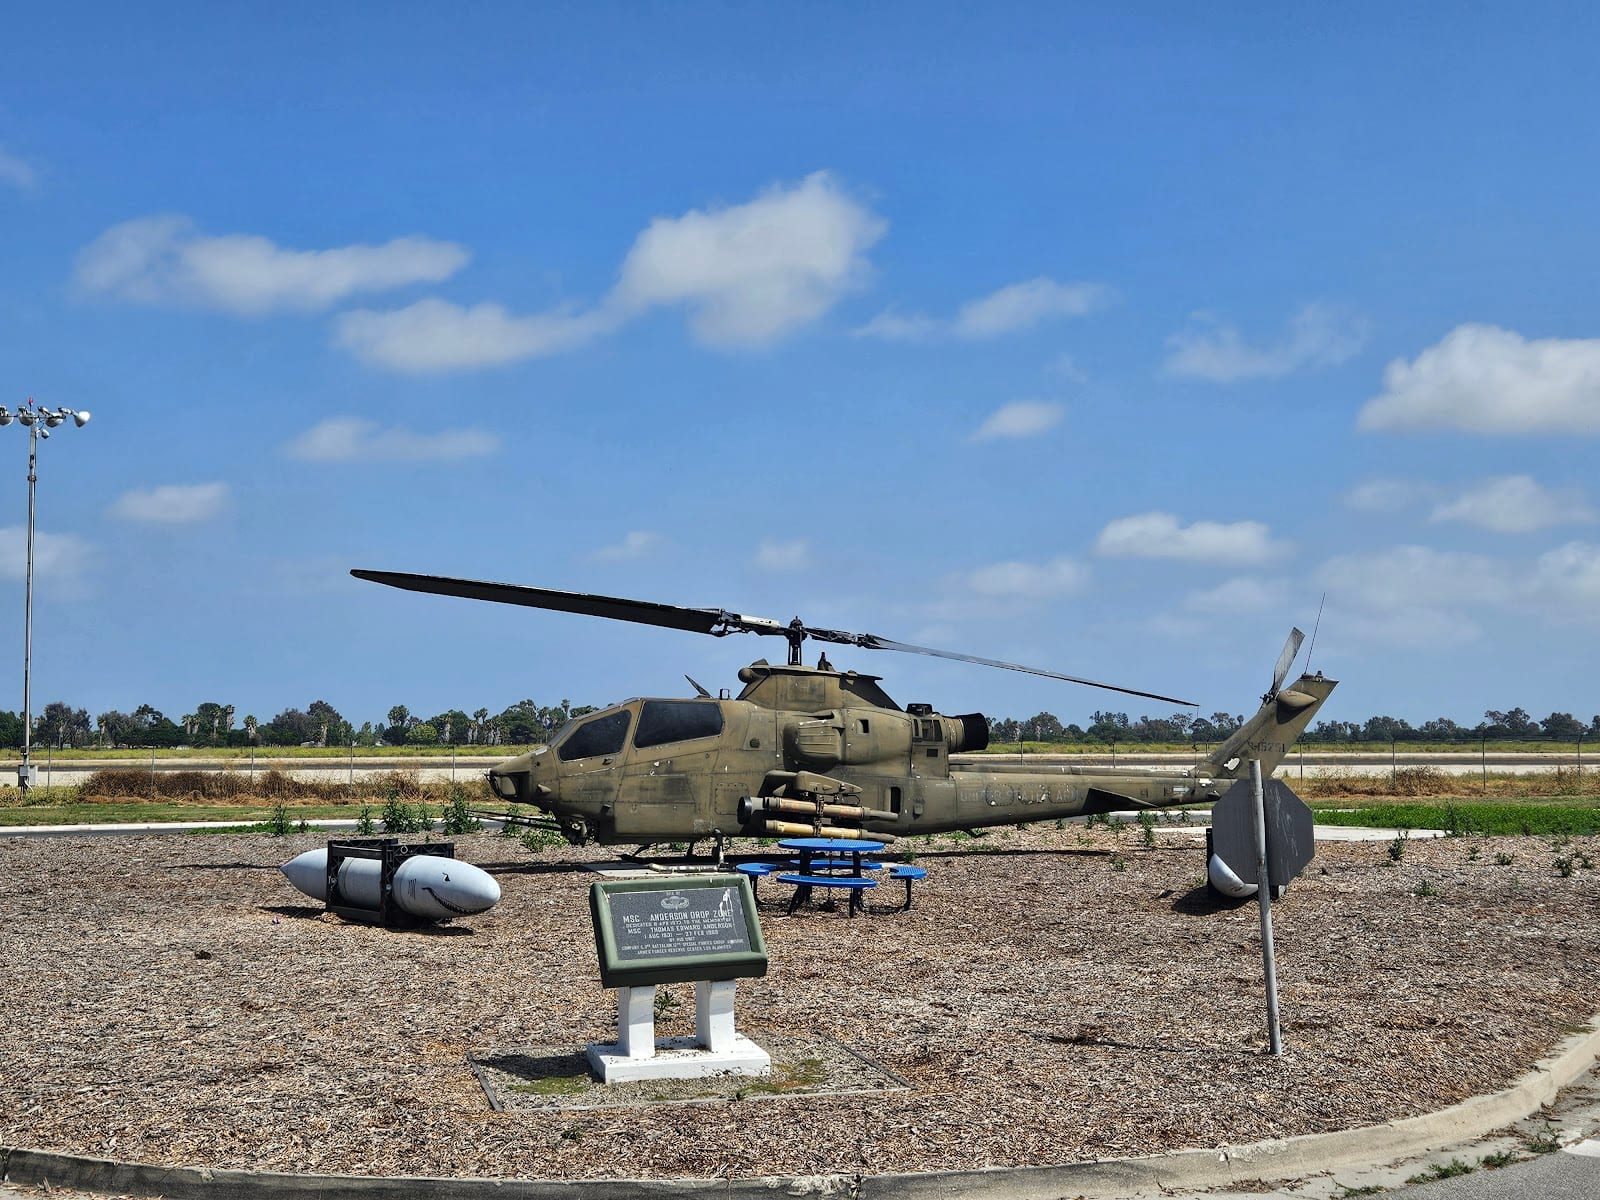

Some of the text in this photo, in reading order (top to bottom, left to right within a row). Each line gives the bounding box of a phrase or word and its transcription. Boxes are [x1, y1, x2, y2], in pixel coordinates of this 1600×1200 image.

[650, 912, 688, 921] ANDERSON
[690, 910, 710, 919] DROP
[712, 909, 733, 918] ZONE
